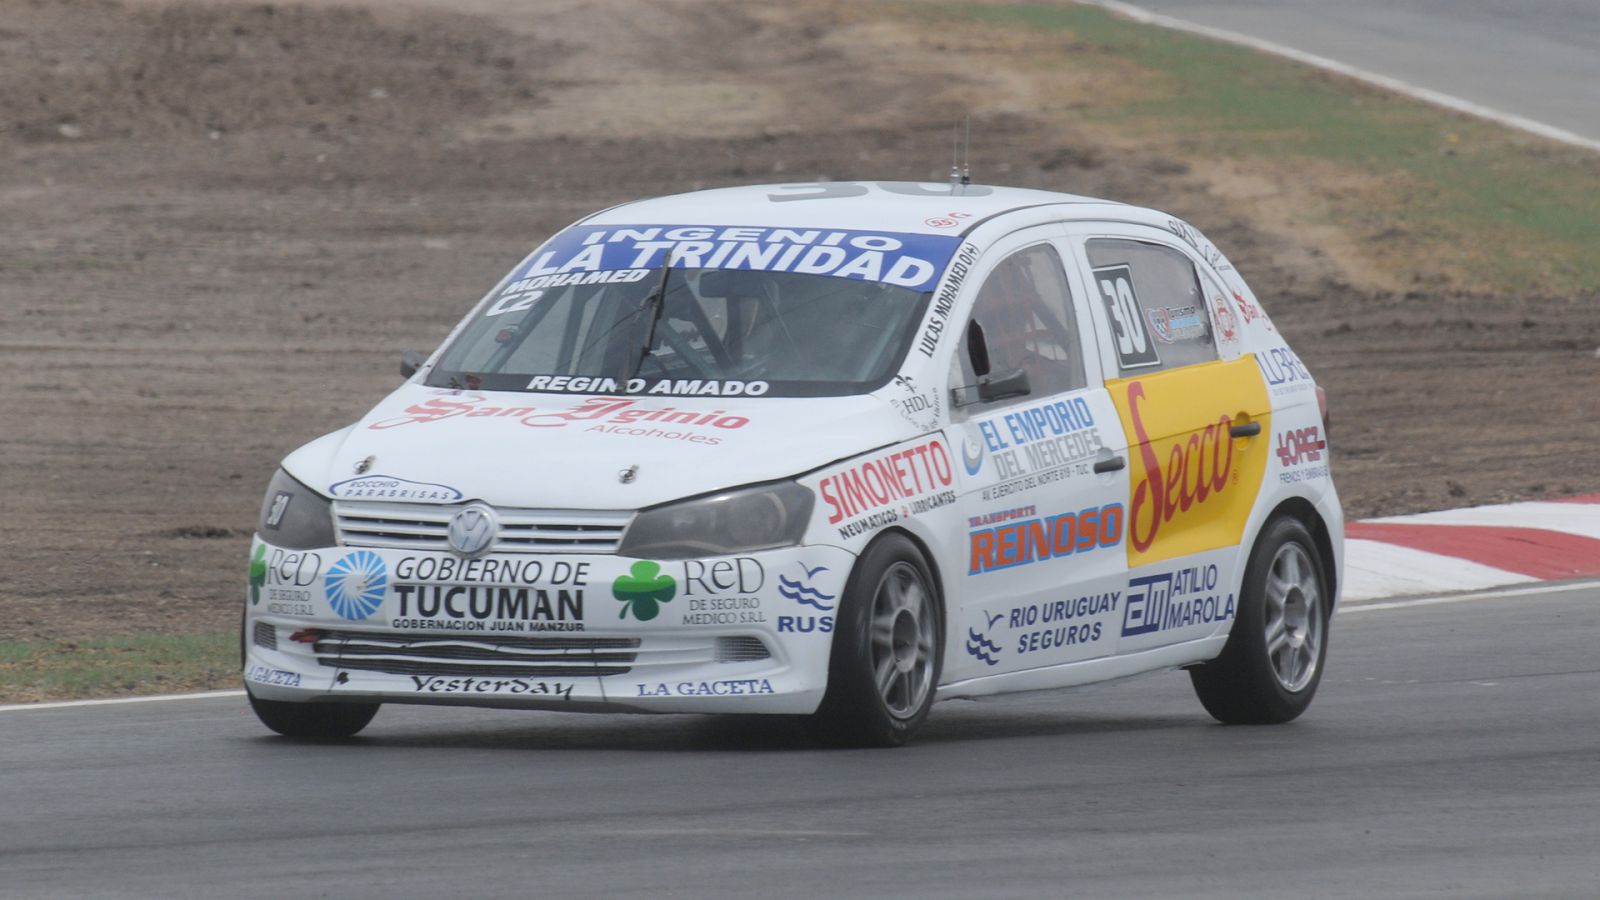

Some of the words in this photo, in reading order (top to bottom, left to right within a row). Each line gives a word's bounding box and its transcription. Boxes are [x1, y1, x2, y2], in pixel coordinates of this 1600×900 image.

[582, 228, 902, 251] INGENIO
[525, 244, 604, 279] LA
[630, 241, 934, 287] TRINIDAD
[502, 269, 650, 295] MOHAMED
[486, 290, 543, 316] C2
[918, 318, 944, 359] LUCAS
[934, 262, 968, 321] MOHAMED
[1100, 277, 1146, 355] 30
[527, 375, 646, 395] REGINO
[648, 378, 769, 397] AMADO
[368, 395, 535, 430] San
[902, 394, 934, 415] HDL
[584, 422, 723, 446] Alcoholes
[978, 420, 1005, 453] EL
[1004, 397, 1095, 442] EMPORIO
[992, 452, 1026, 481] DEL
[1027, 428, 1104, 471] MERCEDES
[1276, 426, 1325, 467] LOPEZ
[819, 440, 952, 524] SIMONETTO
[1128, 381, 1234, 553] Secco
[345, 489, 450, 500] PARABRISAS
[838, 509, 898, 541] NEUMATICOS
[969, 505, 1036, 528] TRANSPORTE
[968, 503, 1124, 576] REINOSO
[396, 557, 542, 584] GOBIERNO
[551, 561, 590, 586] DE
[1171, 564, 1217, 597] ATILIO
[394, 585, 584, 621] TUCUMAN
[682, 612, 737, 625] MEDICO
[690, 599, 708, 611] DE
[711, 597, 760, 610] SEGURO
[1009, 605, 1037, 629] RIO
[1042, 591, 1121, 623] URUGUAY
[1167, 594, 1235, 631] MAROLA
[393, 619, 485, 631] GOBERNACION
[489, 621, 525, 632] JUAN
[529, 622, 585, 632] MANZUR
[778, 616, 834, 633] RUS
[1018, 622, 1103, 654] SEGUROS
[411, 675, 575, 701] Yesterday
[637, 682, 671, 697] LA
[677, 679, 775, 696] GACETA
